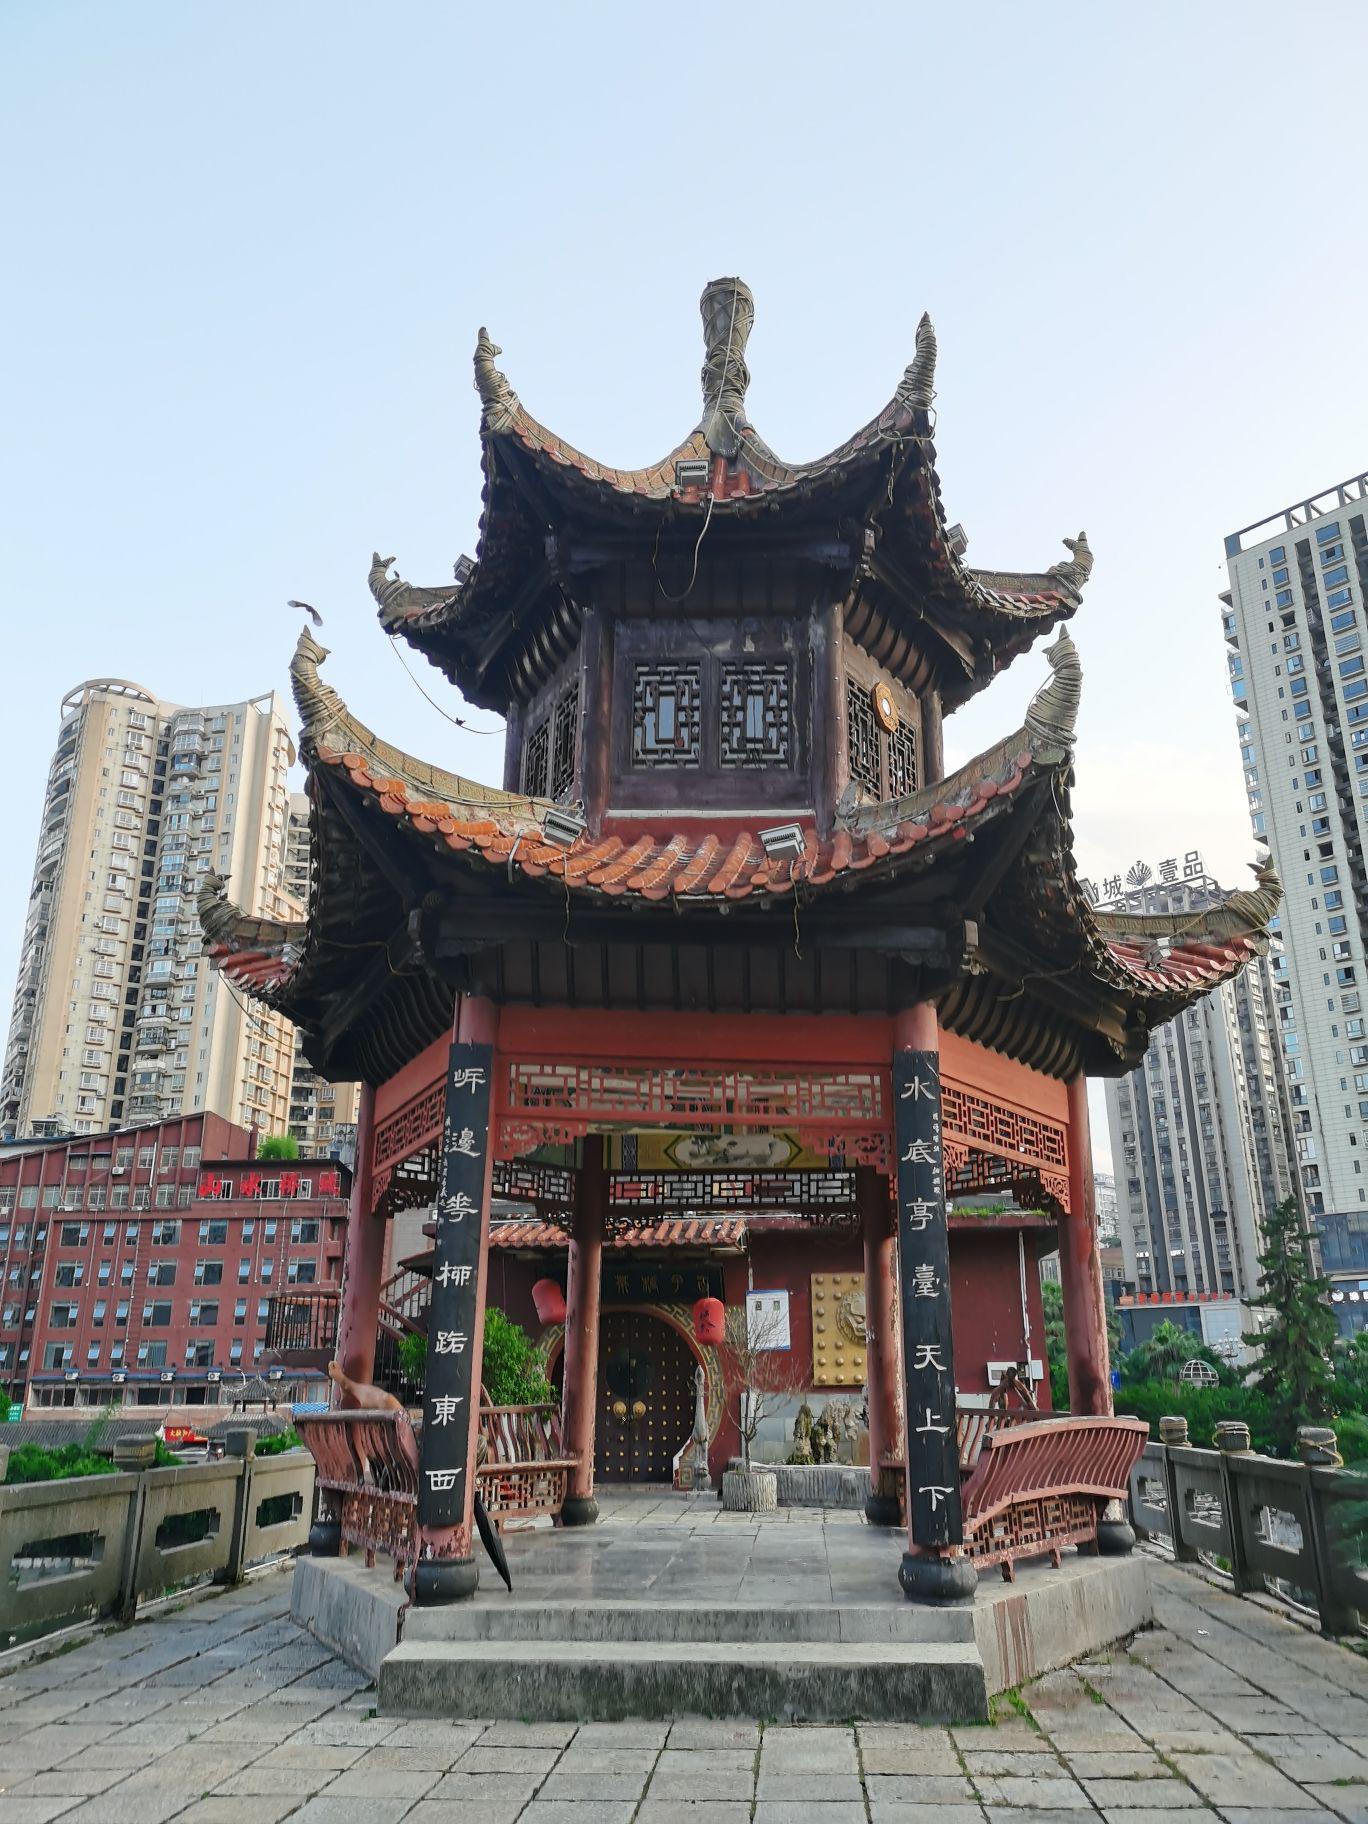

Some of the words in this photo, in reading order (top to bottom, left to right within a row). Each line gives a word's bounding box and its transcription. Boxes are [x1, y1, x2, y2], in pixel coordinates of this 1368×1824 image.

[1158, 850, 1204, 885] 壹品
[900, 1075, 955, 1511] 水底亭臺天上下
